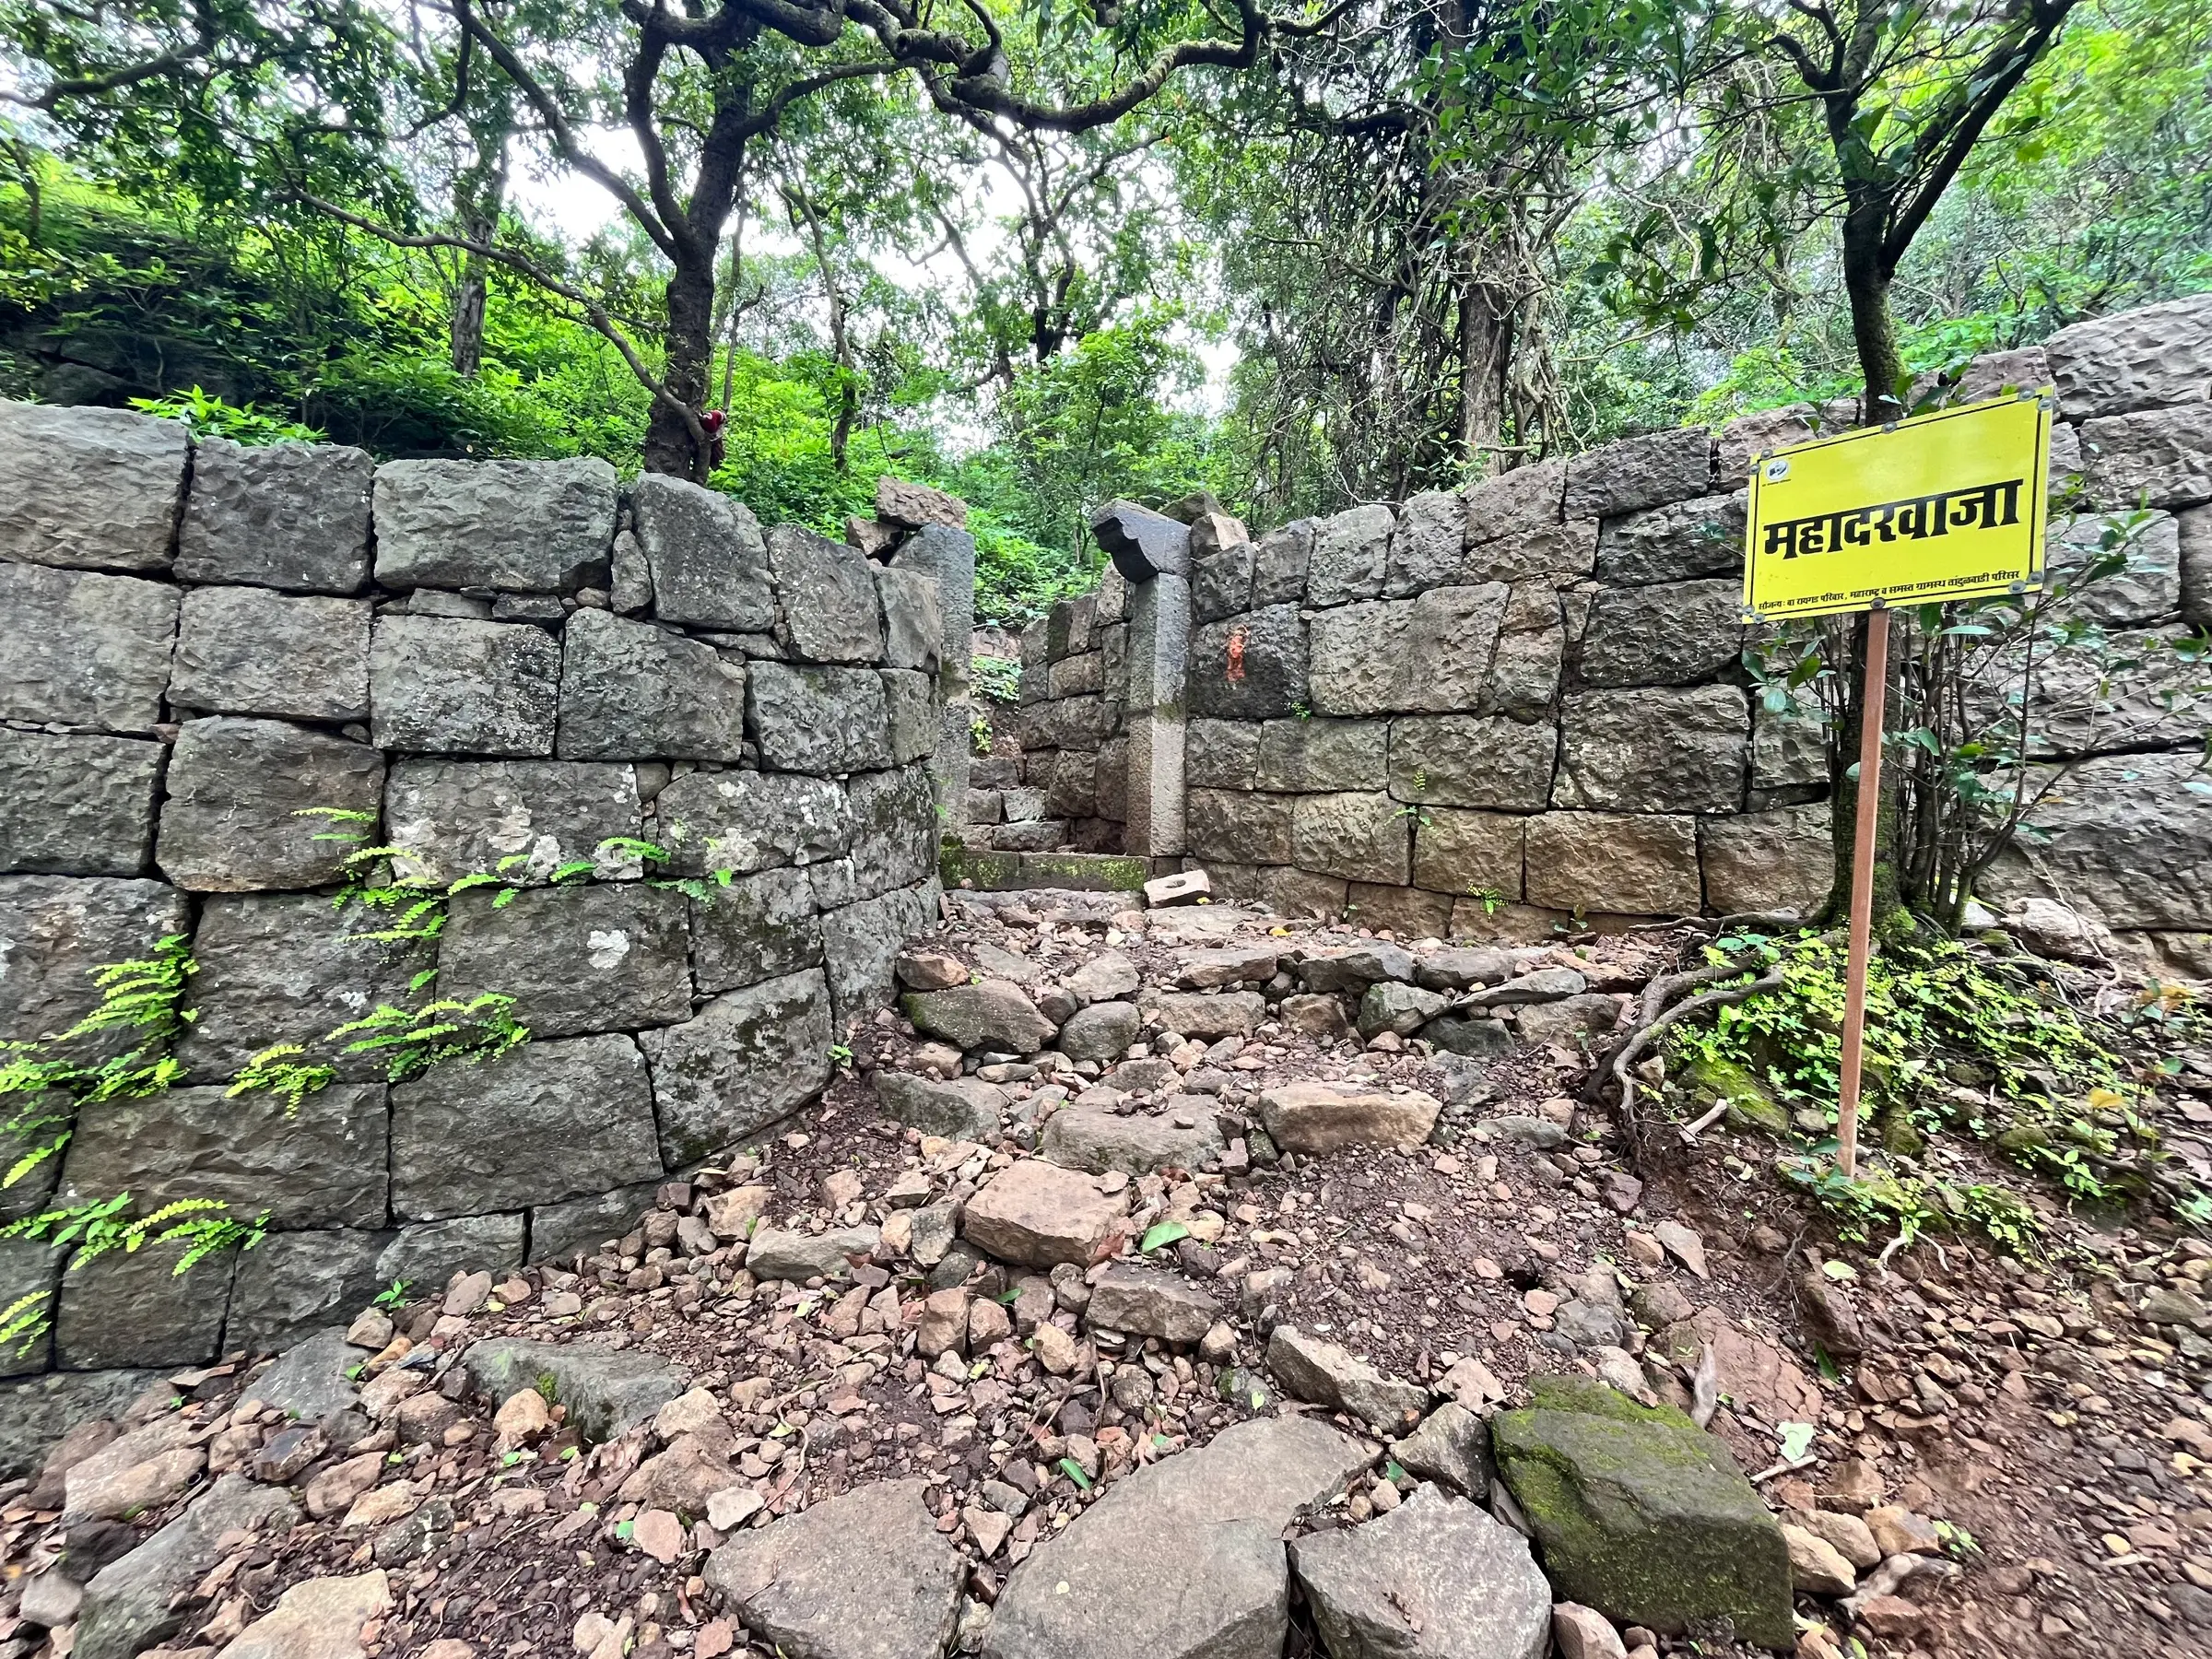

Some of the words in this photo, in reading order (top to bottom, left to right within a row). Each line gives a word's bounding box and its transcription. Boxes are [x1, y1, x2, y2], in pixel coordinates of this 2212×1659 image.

[1763, 478, 2024, 560] महादरवाजा
[1850, 589, 1880, 598] महाराष्ट्र
[1889, 584, 1914, 594] समस्त
[1915, 580, 1946, 590] ग्रामस्थ
[1991, 571, 2020, 581] परिसर
